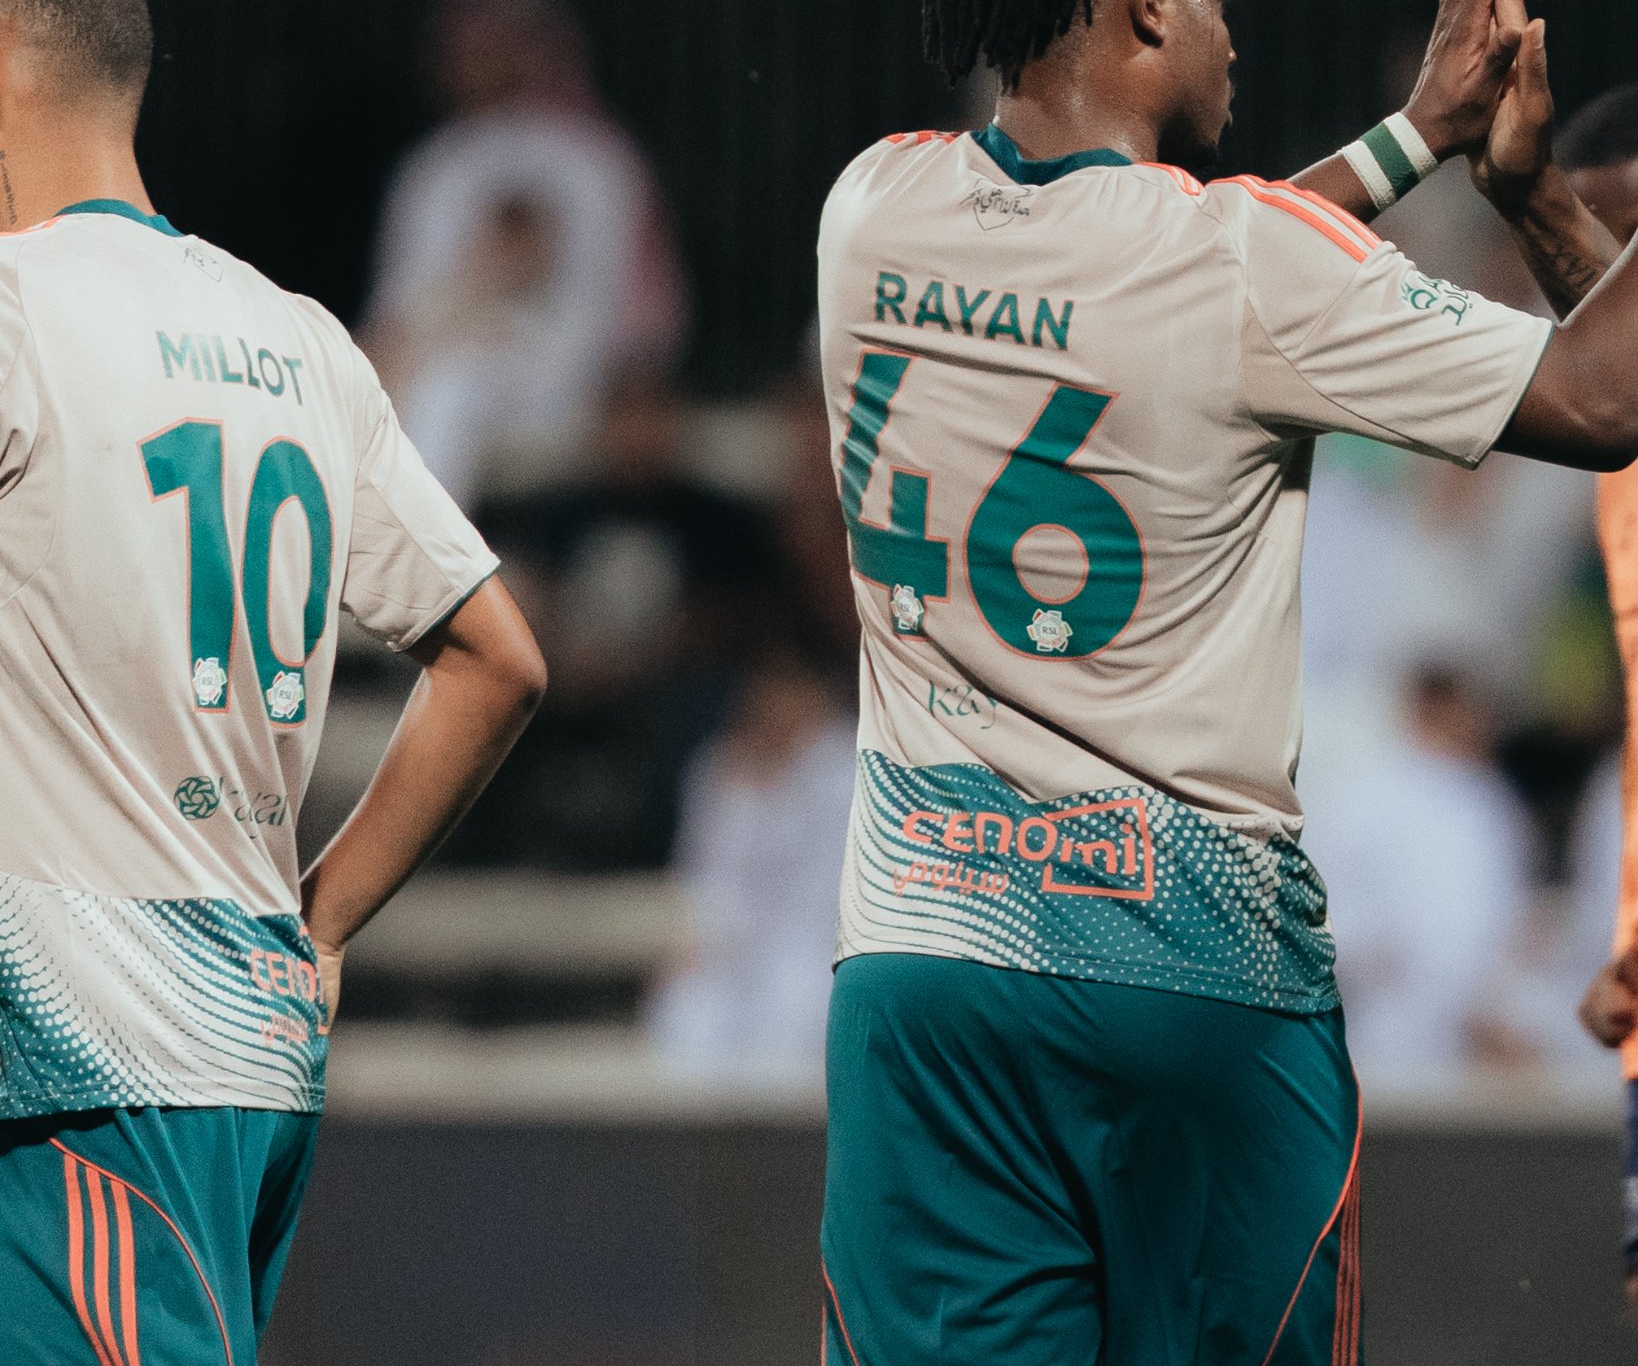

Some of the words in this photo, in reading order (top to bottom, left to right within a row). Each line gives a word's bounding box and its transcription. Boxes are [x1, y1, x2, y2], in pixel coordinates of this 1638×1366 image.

[874, 272, 1075, 351] RAYAN
[156, 331, 303, 406] MILLOT
[839, 346, 1148, 661] 46
[136, 415, 335, 728] 10
[1042, 625, 1058, 636] RSL
